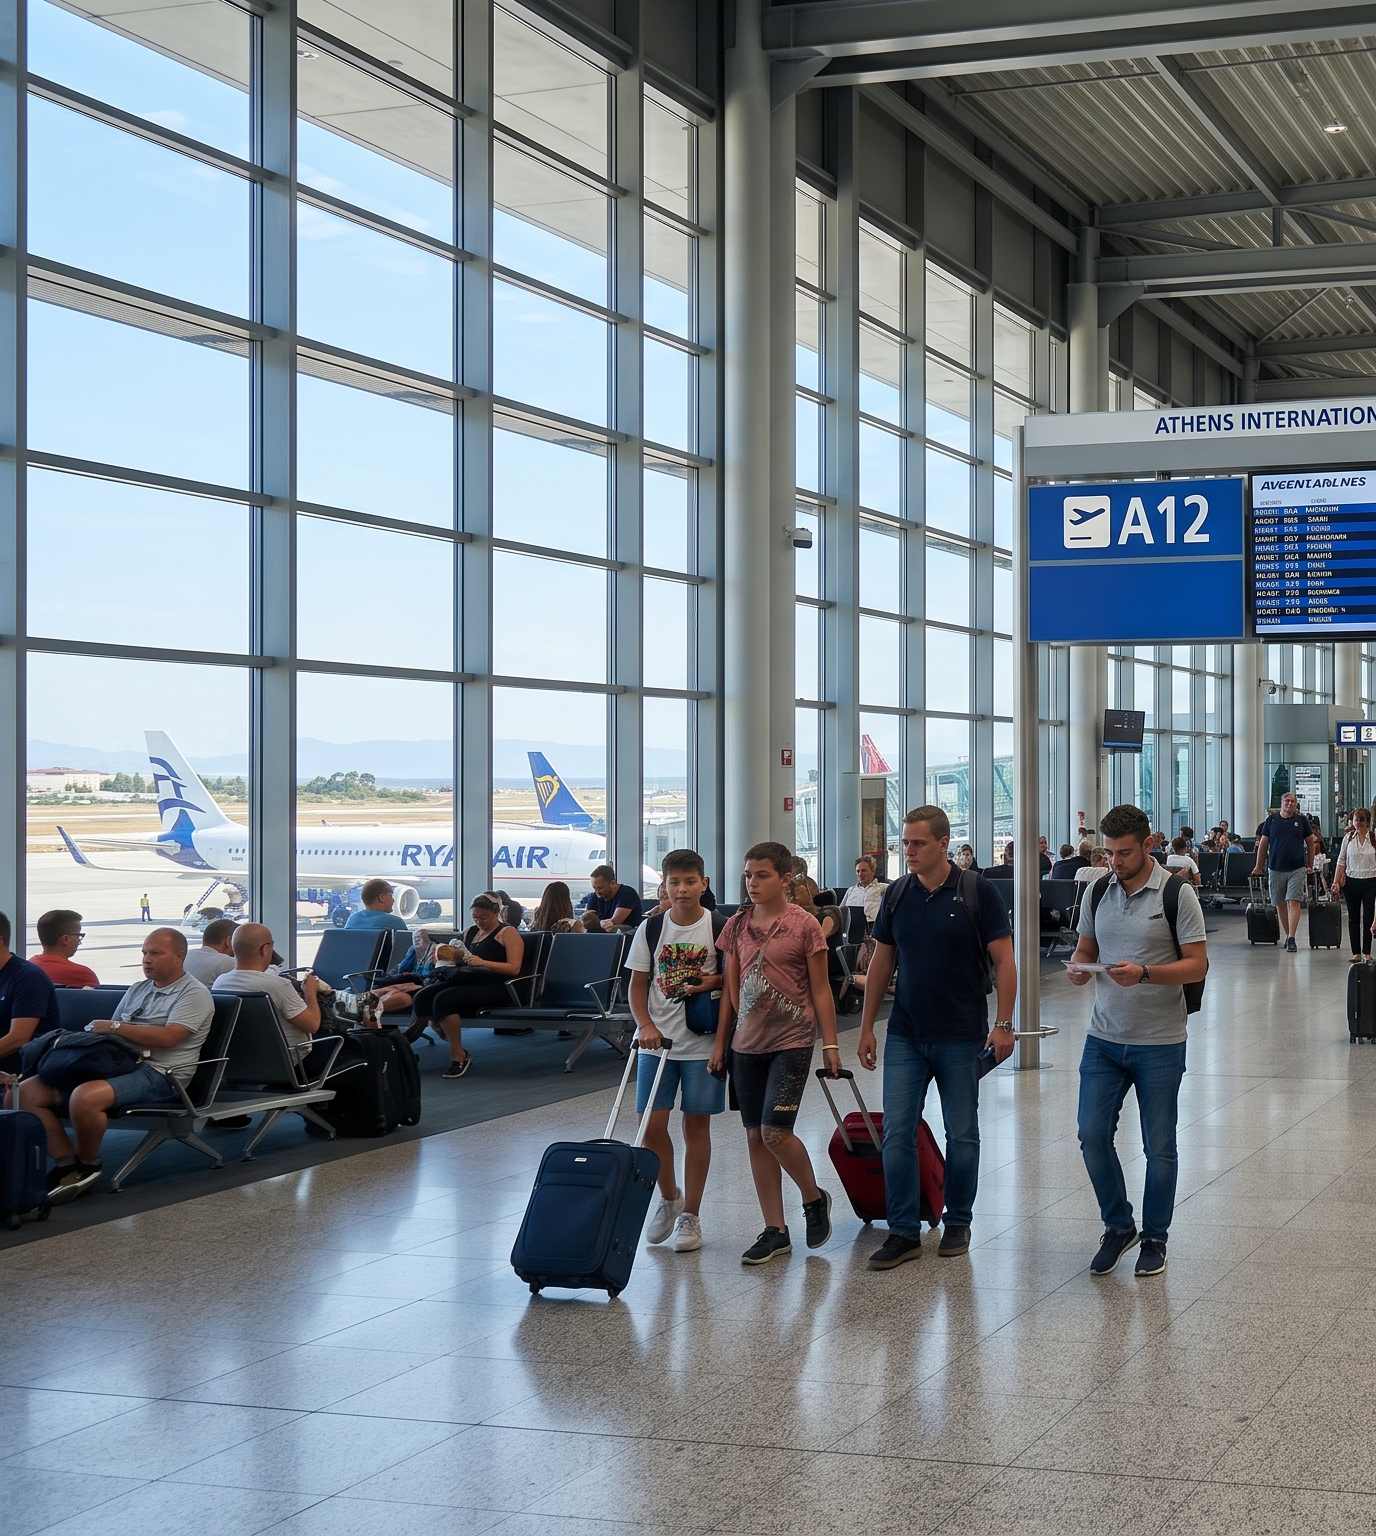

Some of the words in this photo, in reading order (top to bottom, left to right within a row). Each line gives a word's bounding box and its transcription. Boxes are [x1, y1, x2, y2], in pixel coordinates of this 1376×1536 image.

[1155, 413, 1234, 435] ATHENS
[1117, 494, 1210, 545] A12
[401, 844, 551, 869] RYAIR
